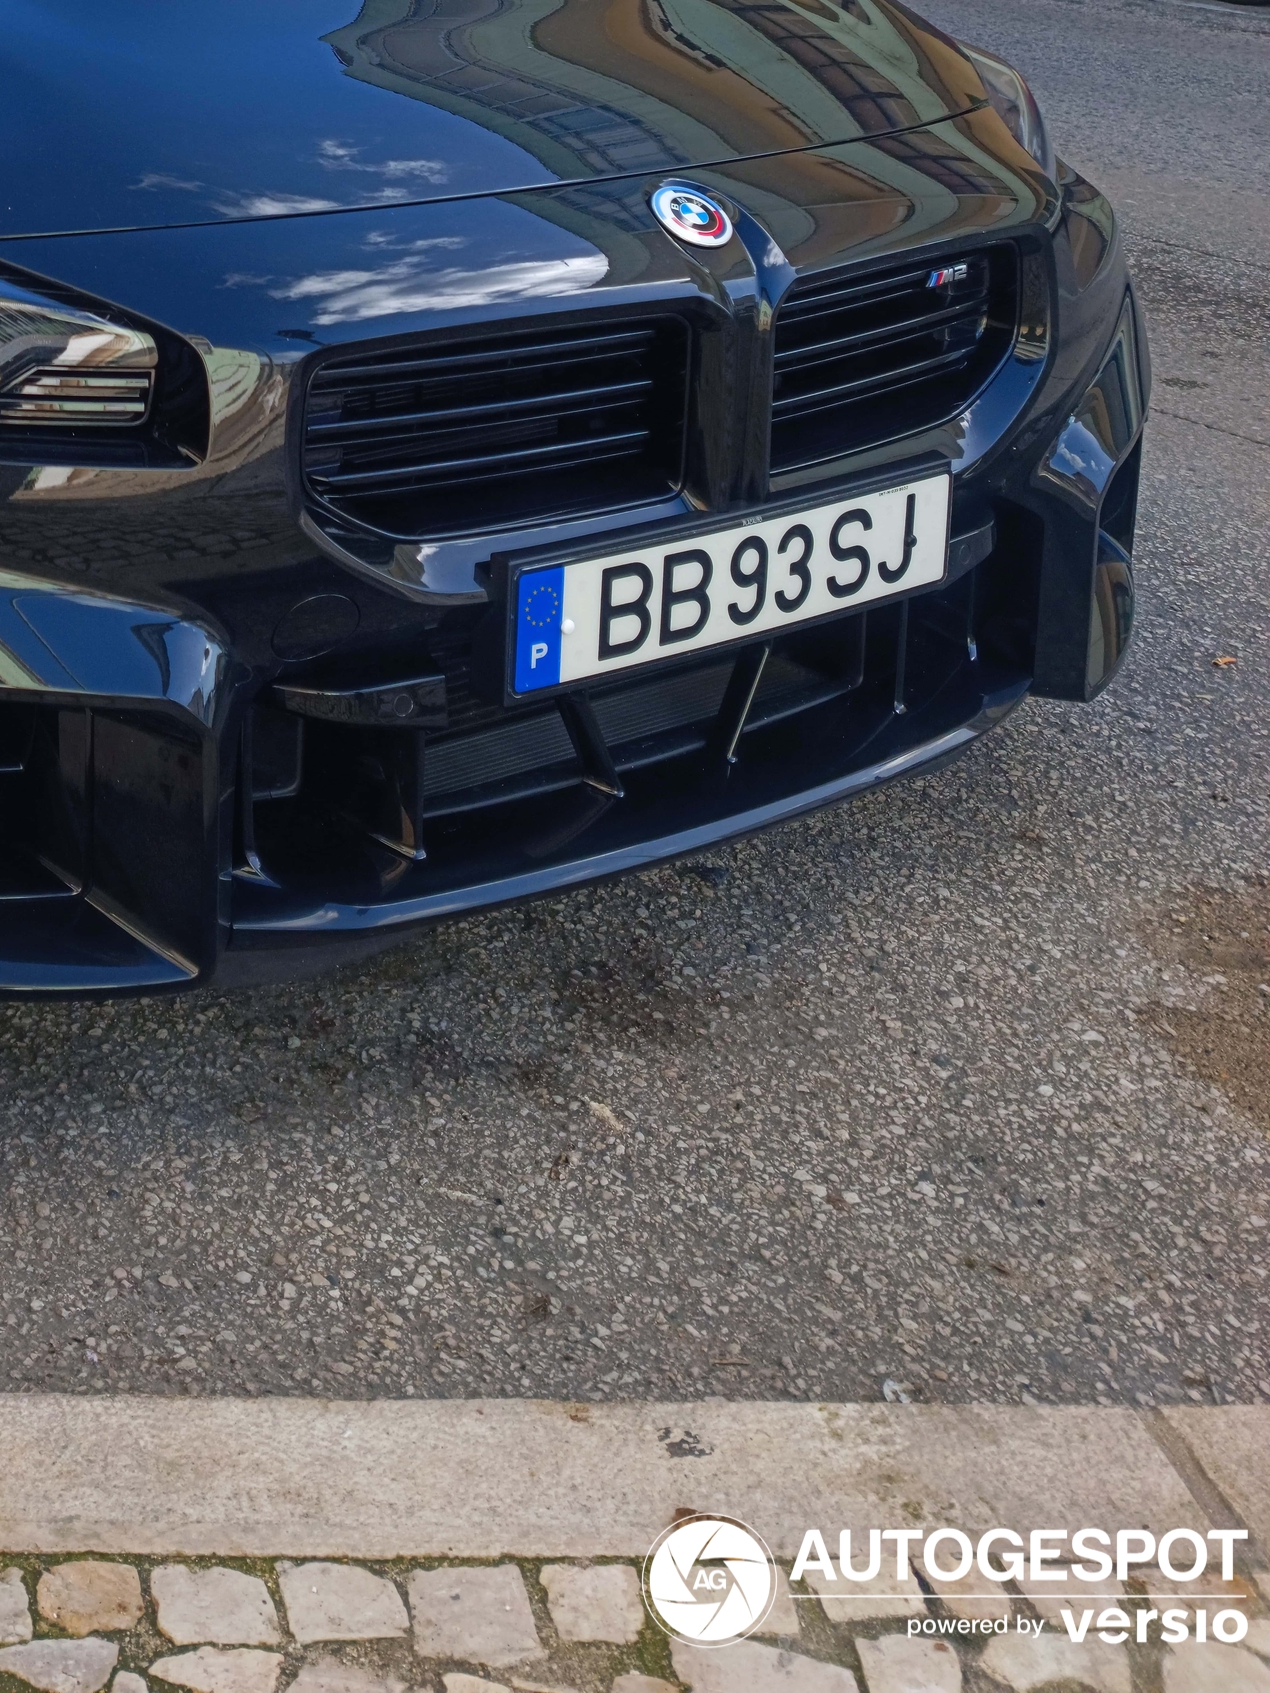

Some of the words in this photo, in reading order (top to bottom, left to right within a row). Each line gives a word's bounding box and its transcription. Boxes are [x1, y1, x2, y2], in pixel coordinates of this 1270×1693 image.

[671, 195, 704, 211] BMW
[943, 263, 968, 284] M2
[530, 642, 549, 670] P
